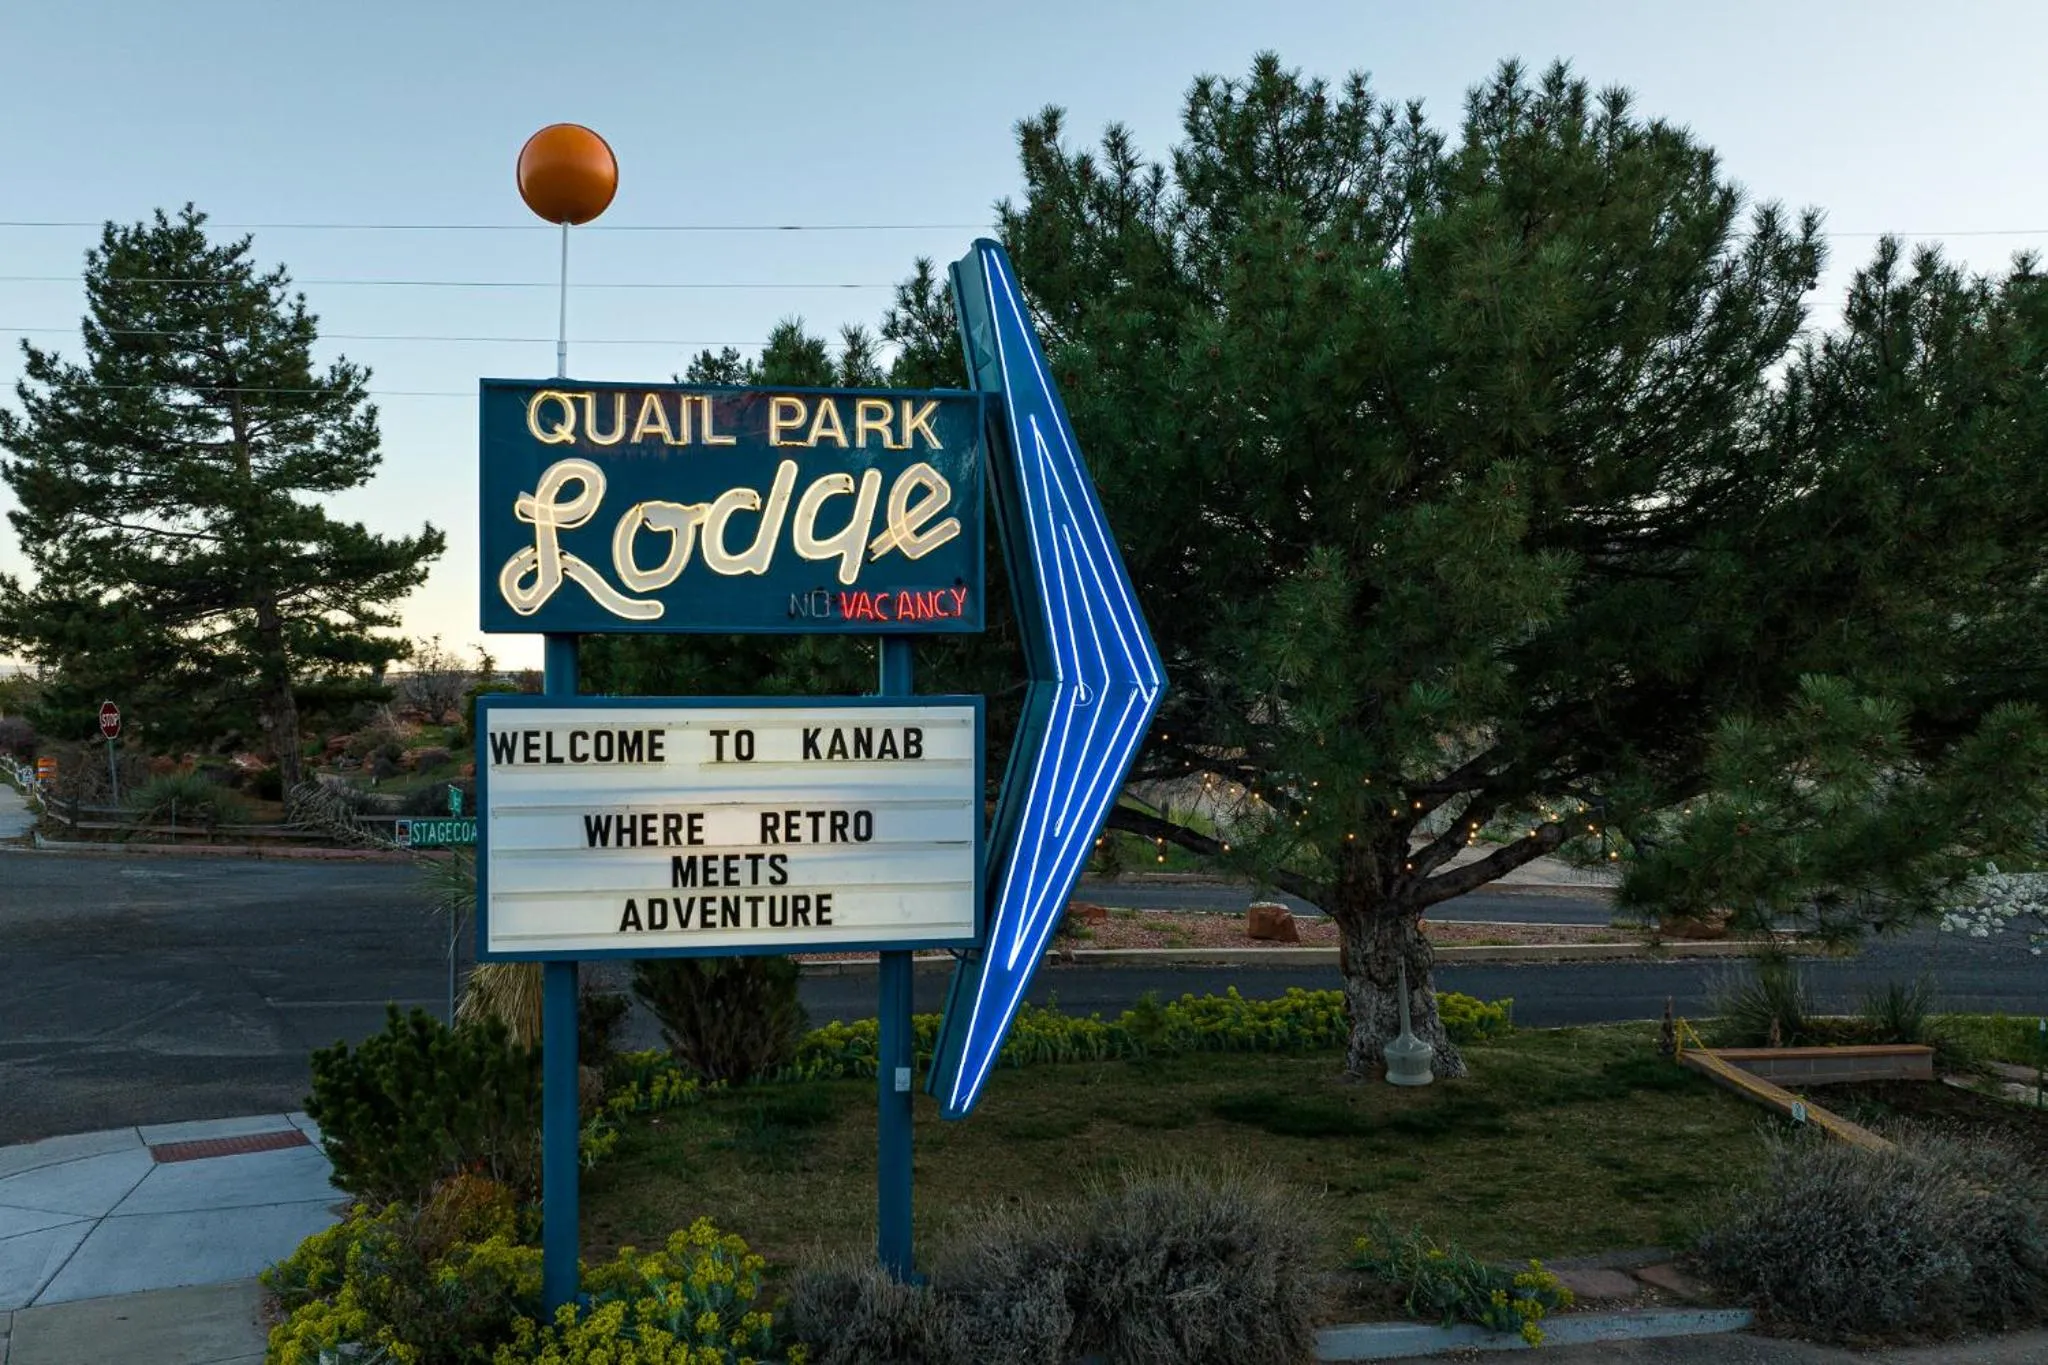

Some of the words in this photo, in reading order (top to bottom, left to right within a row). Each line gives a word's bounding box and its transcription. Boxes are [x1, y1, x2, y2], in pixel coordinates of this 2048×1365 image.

[526, 390, 737, 447] QUAIL
[768, 395, 944, 451] PARK
[498, 458, 962, 621] Lodge
[789, 589, 831, 618] NO
[838, 586, 967, 622] VACANCY
[102, 713, 119, 727] STOP
[490, 729, 666, 765] WELCOME
[709, 729, 756, 763] TO
[802, 727, 925, 761] KANAB
[584, 813, 705, 848] WHERE
[760, 810, 874, 845] RETRO
[671, 853, 790, 888] MEETS
[618, 893, 834, 932] ADVENTURE
